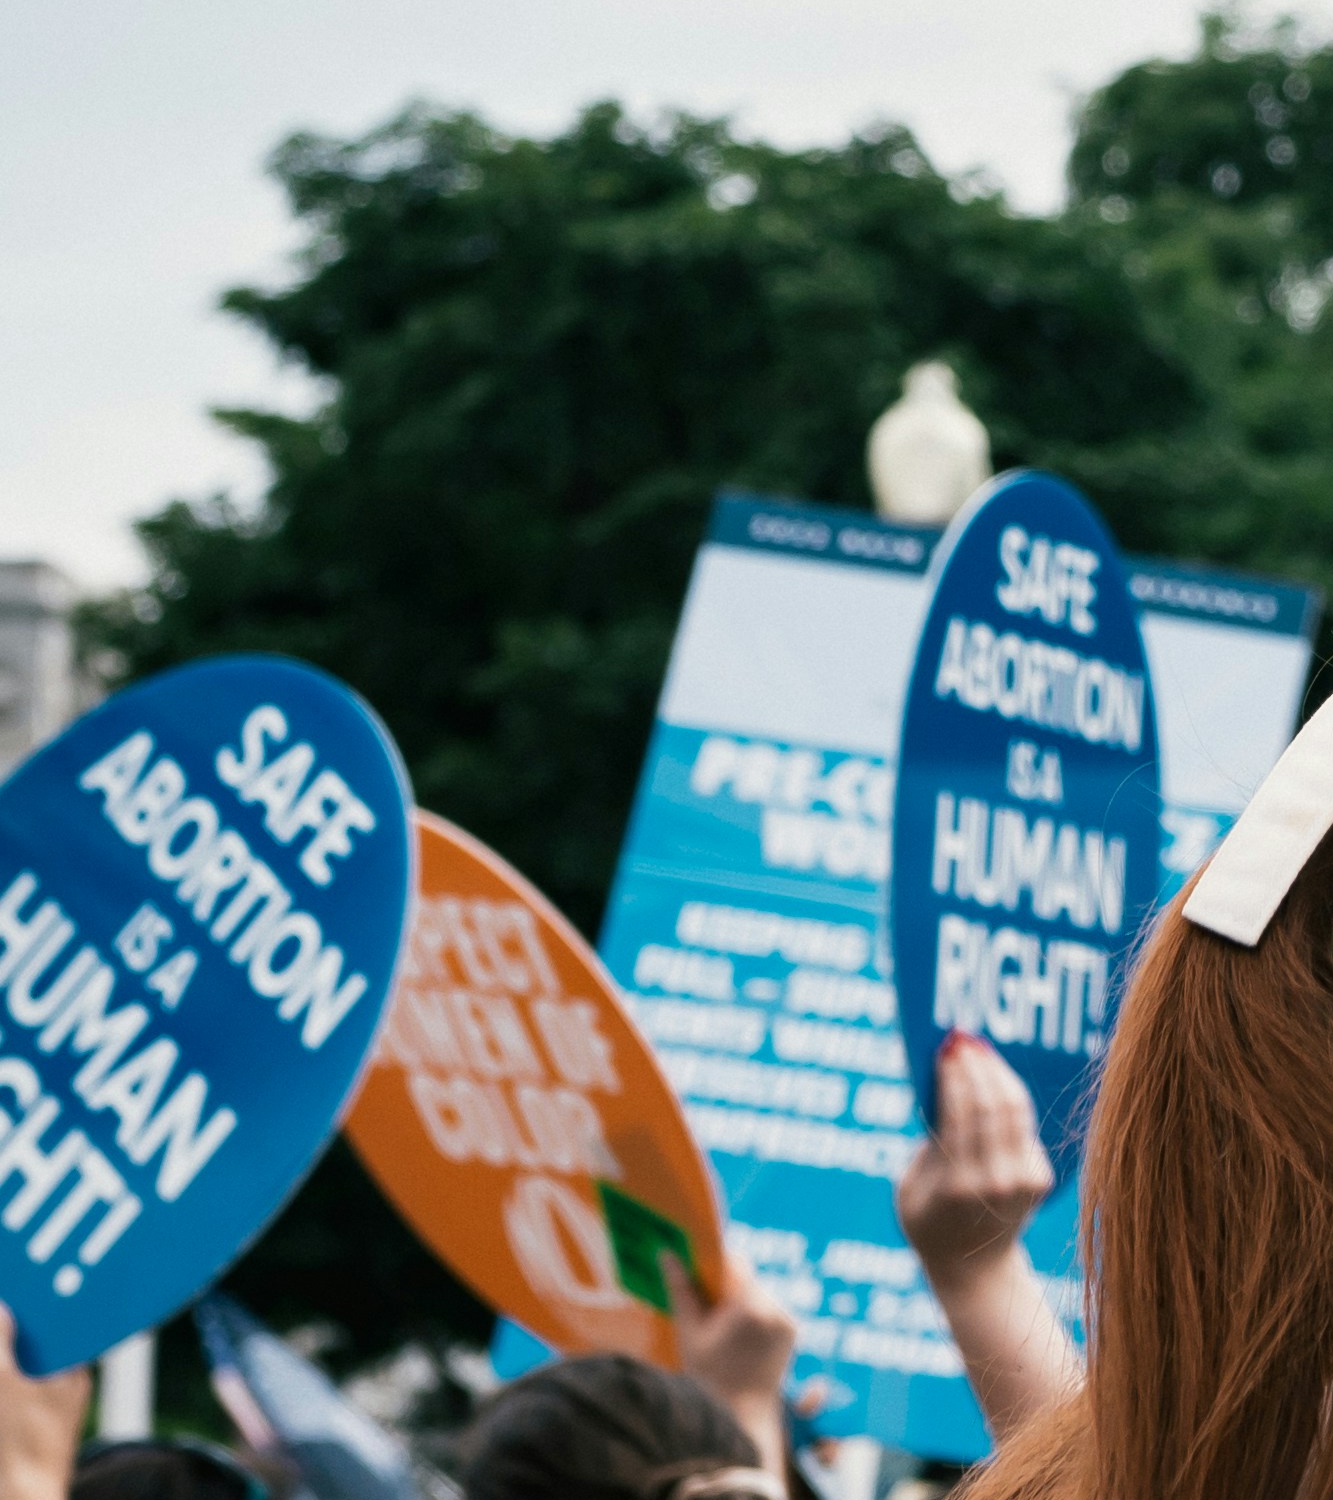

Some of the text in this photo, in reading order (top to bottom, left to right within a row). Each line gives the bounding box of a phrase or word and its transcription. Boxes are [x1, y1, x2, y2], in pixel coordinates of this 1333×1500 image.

[997, 525, 1100, 637] SAFE
[933, 618, 1144, 754] ABORTION
[215, 703, 379, 888] SAFE
[1005, 740, 1063, 803] IS A
[79, 730, 369, 1051] ABORTION
[931, 792, 1127, 936] HUMAN
[113, 903, 199, 1012] IS A
[935, 912, 1110, 1058] RIGHT!
[0, 872, 238, 1203] HUMAN
